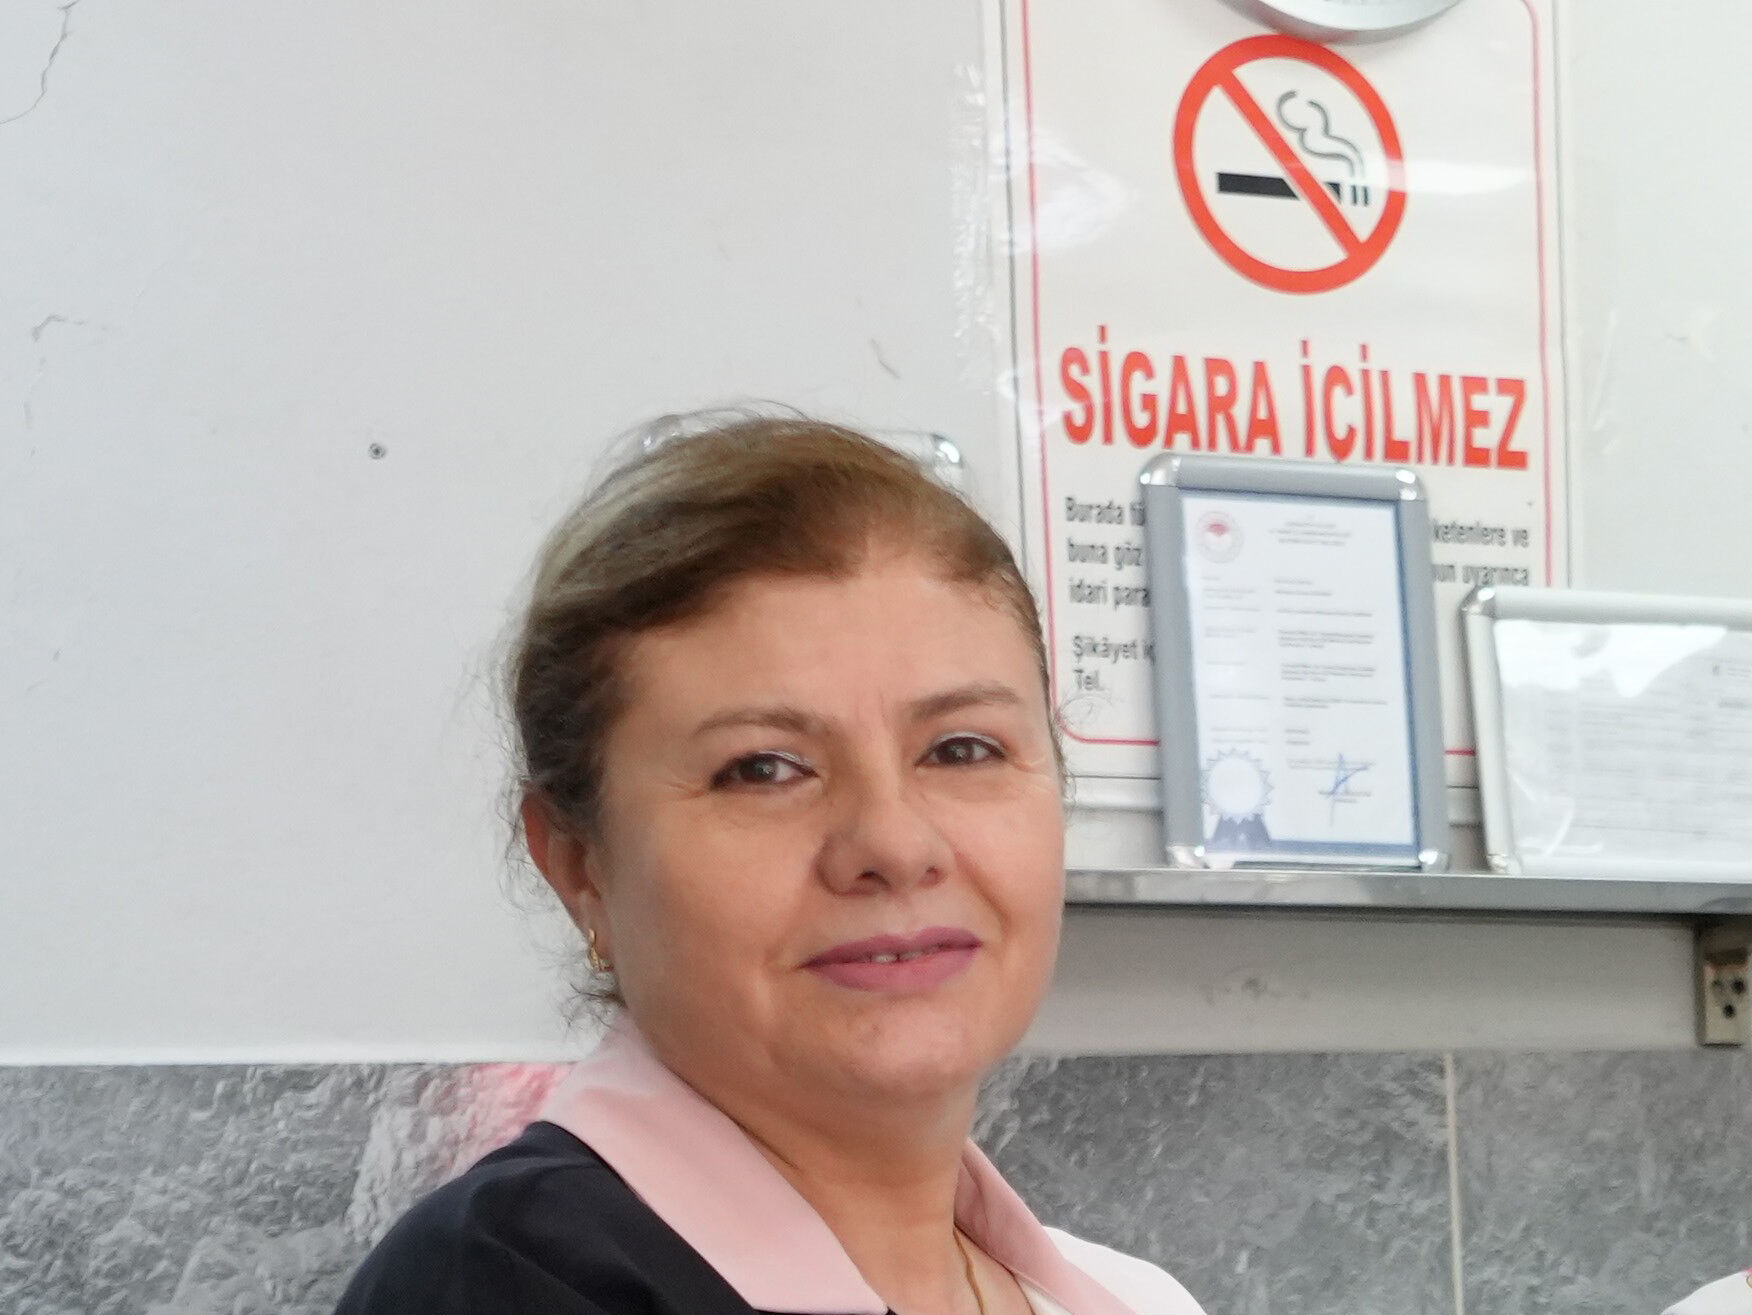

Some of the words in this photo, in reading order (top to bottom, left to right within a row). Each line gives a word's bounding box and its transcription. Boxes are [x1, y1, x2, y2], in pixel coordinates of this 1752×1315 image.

[1060, 324, 1282, 456] SİGARA
[1064, 496, 1124, 525] Burada
[1068, 537, 1108, 565] buna
[1069, 576, 1109, 604] idari
